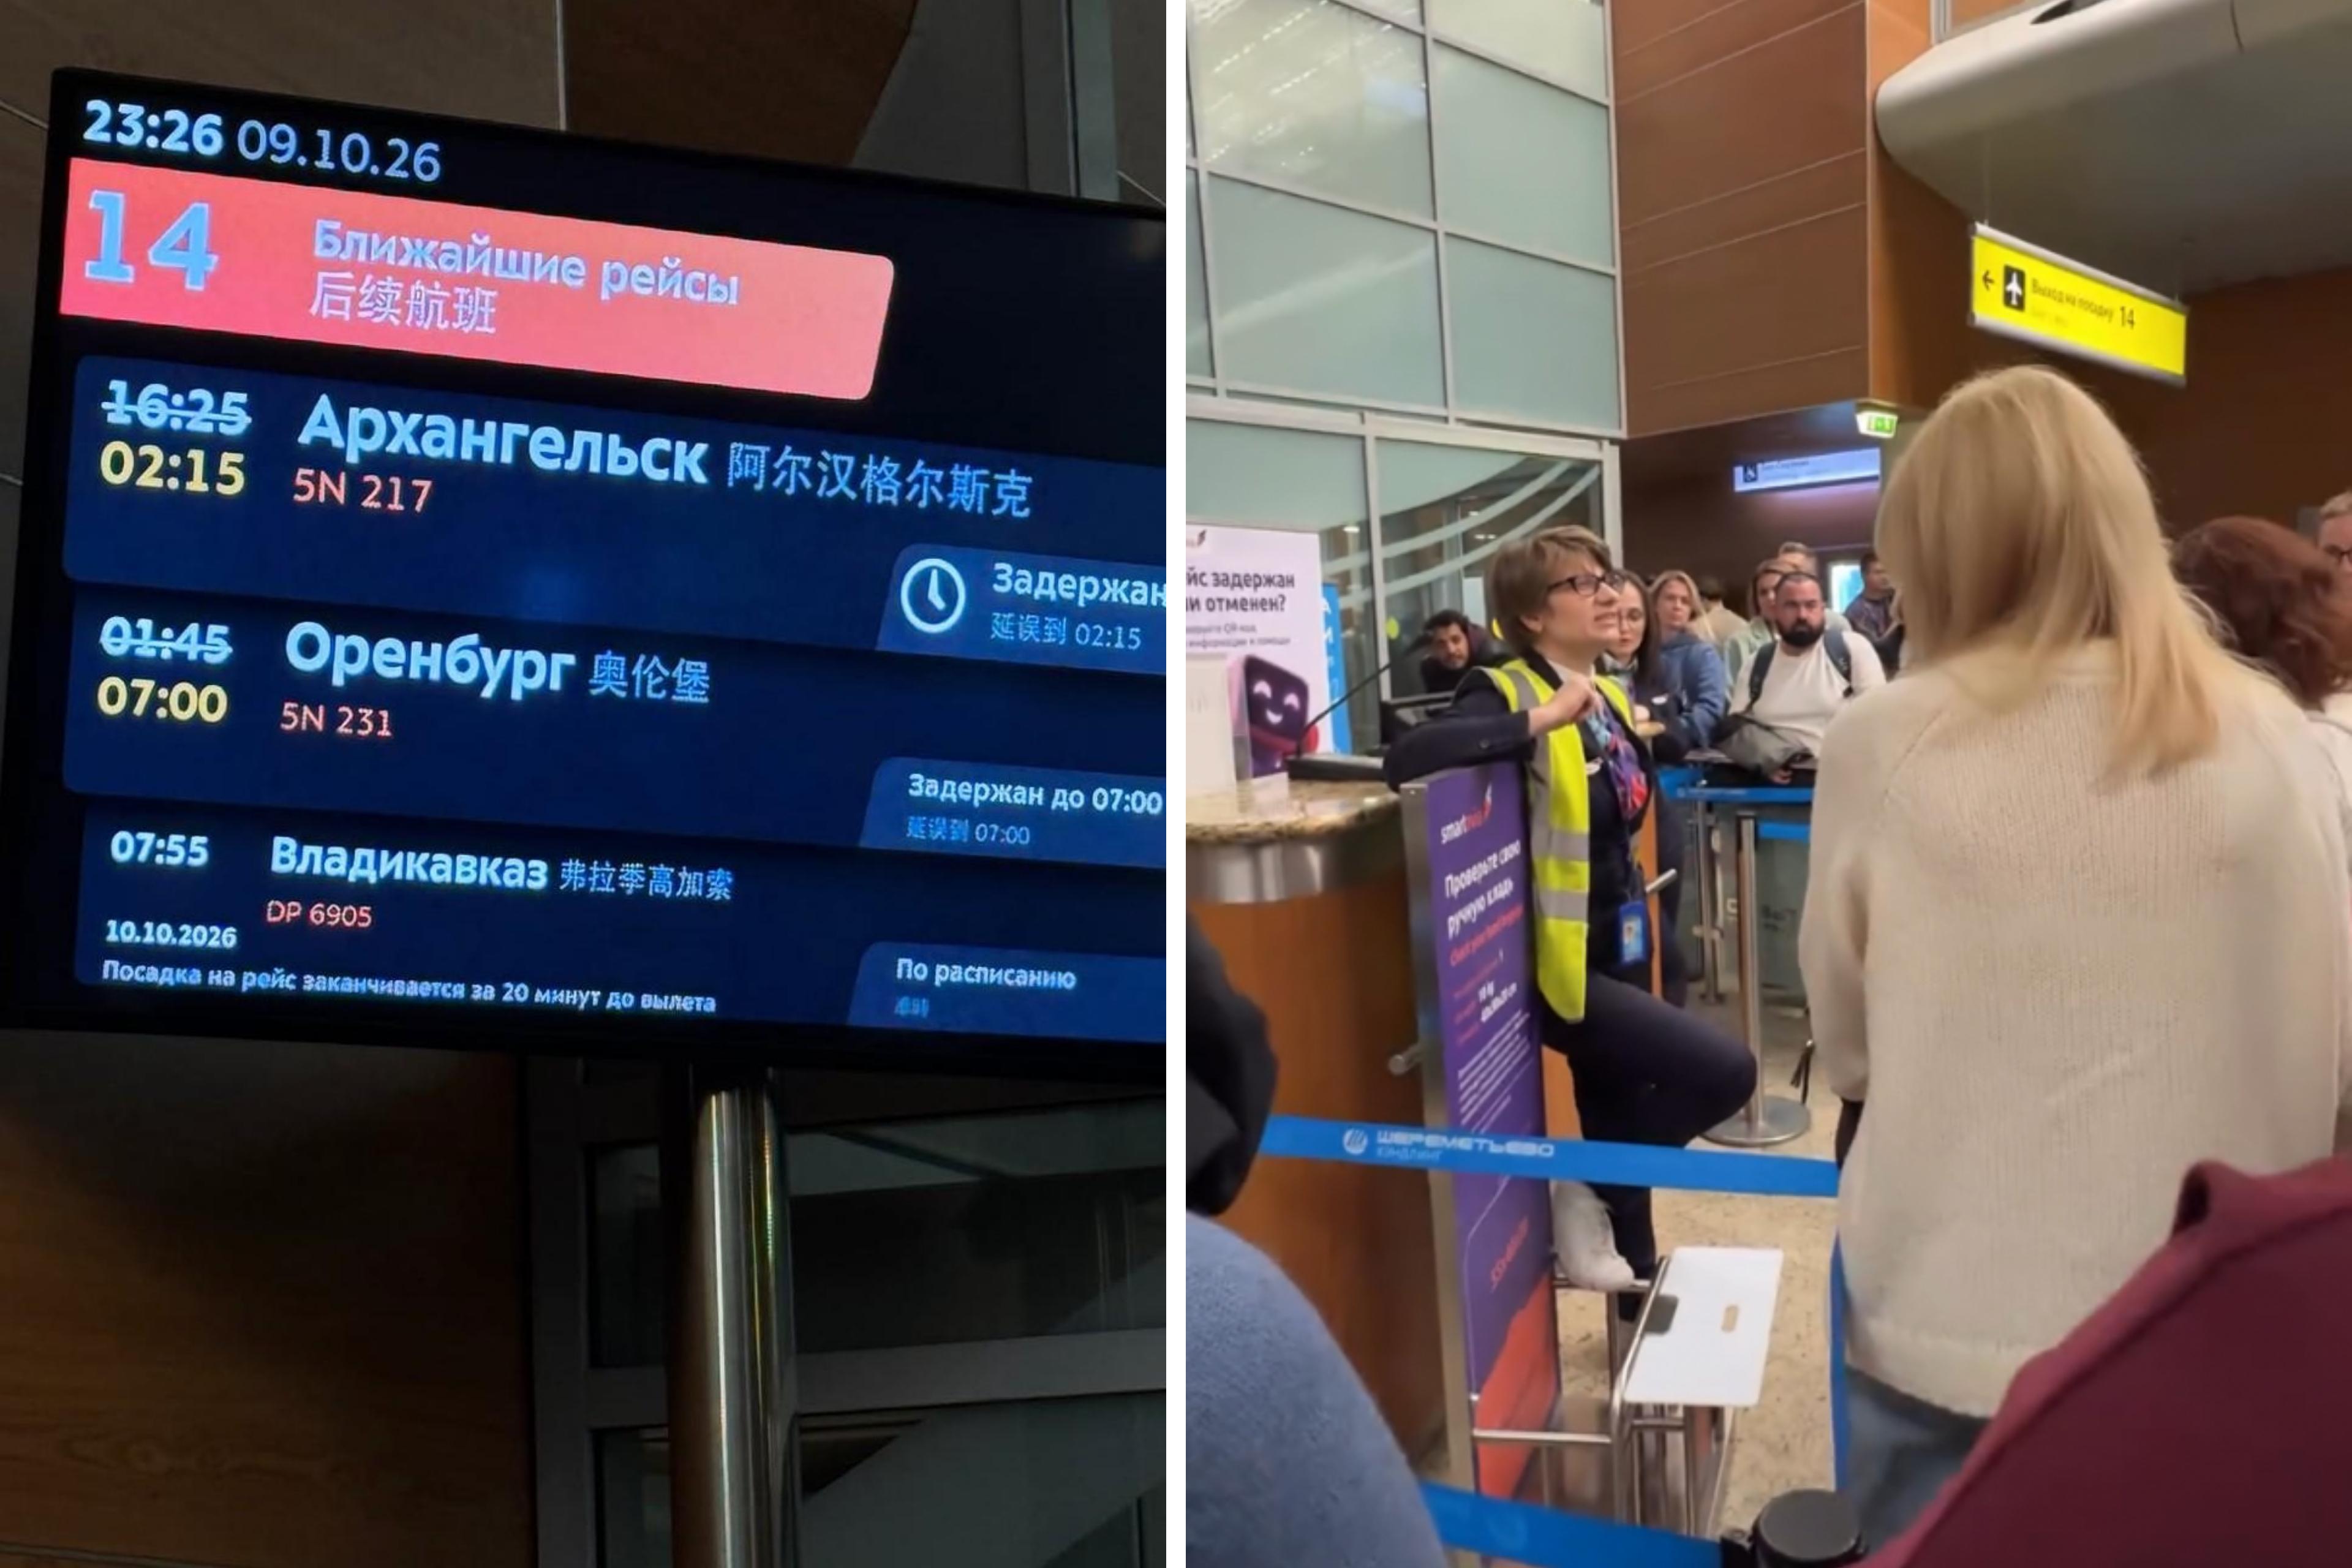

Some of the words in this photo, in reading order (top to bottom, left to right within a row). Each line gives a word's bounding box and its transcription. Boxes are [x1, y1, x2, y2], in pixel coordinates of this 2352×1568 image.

[83, 99, 223, 155] 23:26
[237, 120, 442, 182] 09.10.26
[85, 189, 219, 291] 14
[314, 219, 586, 287] Ближайшие
[600, 256, 739, 305] рейсы
[309, 271, 497, 334] 后续航班
[2120, 306, 2135, 329] 14
[102, 380, 251, 435] 16:25
[100, 440, 246, 495] 02:15
[297, 393, 709, 484] Архангельск
[727, 442, 1034, 518] 阿尔汉格尔斯克
[293, 467, 345, 505] 5N
[361, 475, 432, 513] 217
[992, 562, 1166, 607] Задержан
[1186, 567, 1208, 588] йс
[1211, 571, 1295, 592] задержан
[1186, 596, 1201, 612] и
[1205, 594, 1286, 612] отменен?
[99, 616, 233, 665] 01:45
[990, 612, 1066, 644] 延误到
[1076, 623, 1141, 650] 02:15
[285, 621, 576, 701] Оренбург
[588, 649, 710, 703] 奥伦堡
[97, 676, 227, 723] 07:00
[280, 701, 325, 732] 5N
[337, 706, 392, 737] 231
[908, 773, 1044, 808] Задержан
[1051, 788, 1084, 811] до
[1093, 788, 1163, 815] 07:00
[110, 831, 209, 867] 07:55
[974, 824, 1030, 845] 07:00
[271, 835, 548, 890] Владикавказ
[105, 919, 238, 948] 10.10.2026
[266, 899, 301, 923] DP
[309, 902, 373, 927] 6905
[102, 959, 202, 986] Посадка
[208, 969, 235, 986] на
[241, 968, 297, 992] рейс
[303, 973, 465, 999] заканчивается
[470, 984, 496, 1001] за
[502, 982, 529, 1003] 20
[534, 987, 600, 1011] минут
[605, 992, 634, 1011] до
[640, 992, 717, 1012] вылета
[897, 958, 928, 981] По
[934, 963, 1077, 990] расписанию
[1376, 1130, 1555, 1156] ШЕРЕМЕТЬЕВО
